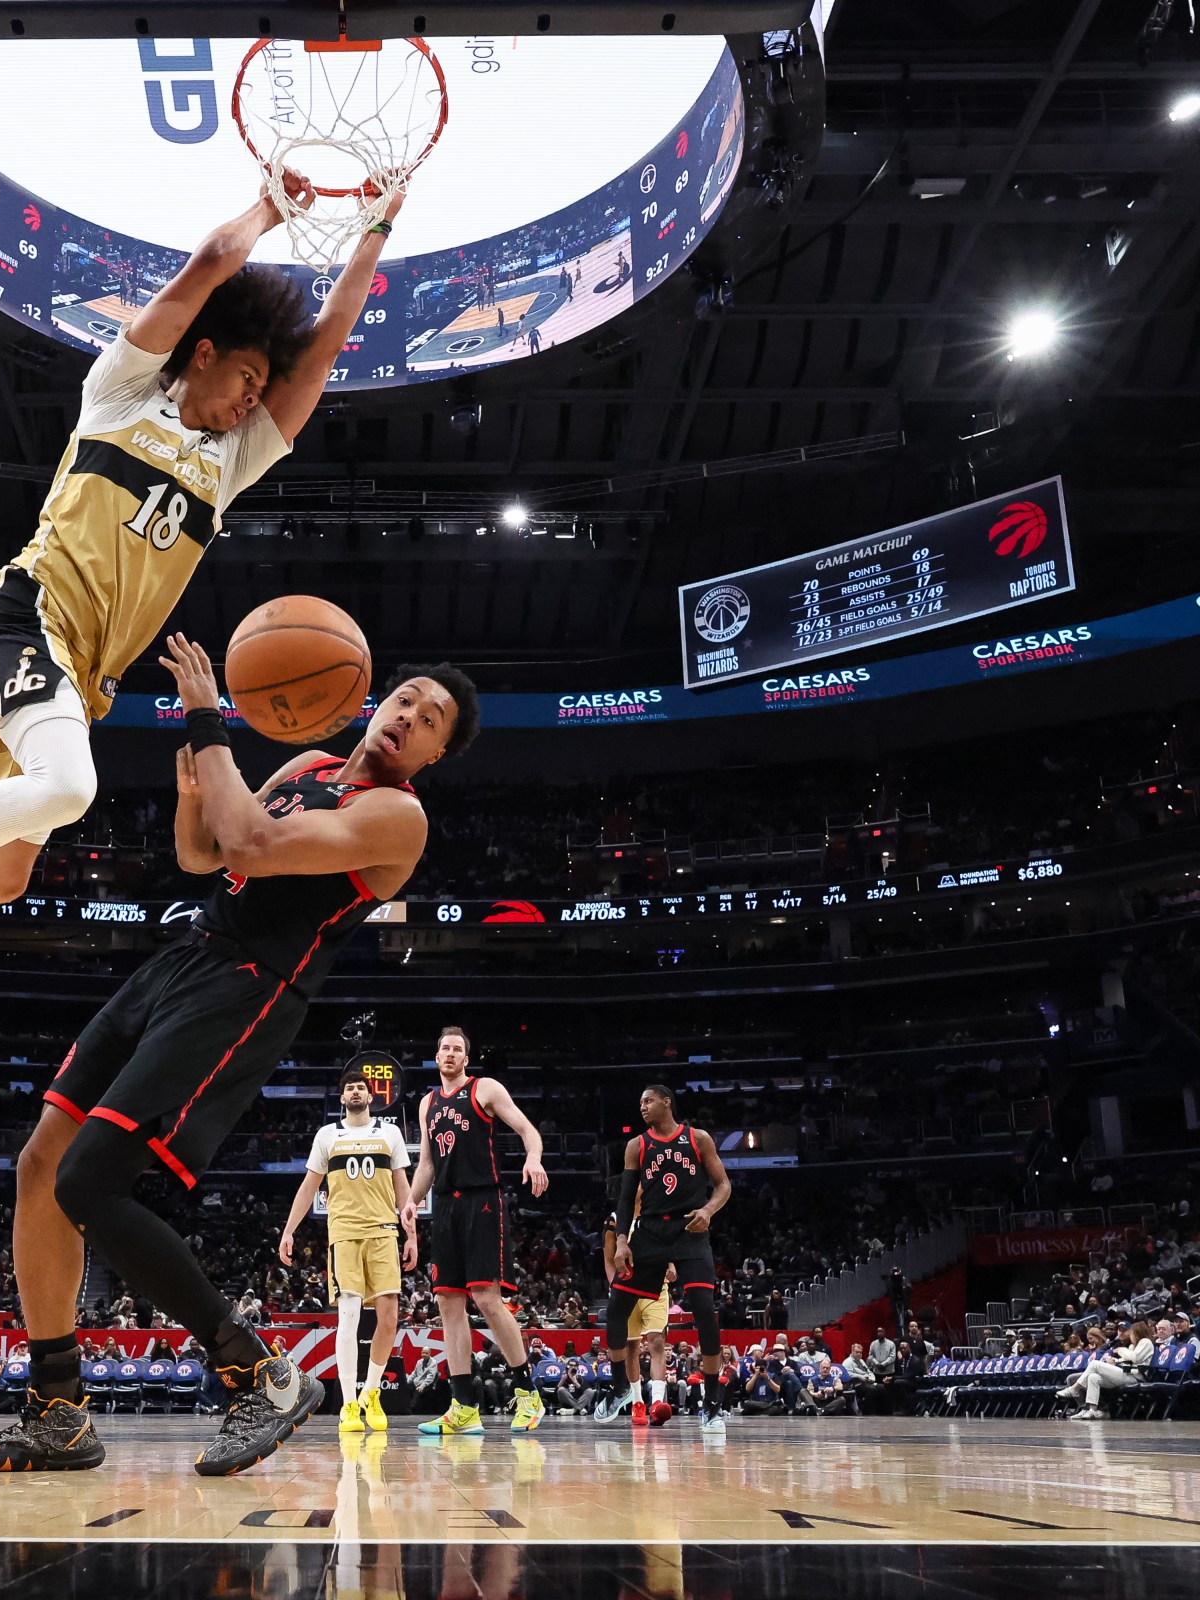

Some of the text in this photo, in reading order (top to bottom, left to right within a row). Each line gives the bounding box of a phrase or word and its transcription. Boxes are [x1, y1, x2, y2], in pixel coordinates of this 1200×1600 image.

[675, 170, 689, 194] 69
[642, 202, 658, 224] 70
[683, 226, 696, 250] :12
[19, 240, 38, 260] 69
[646, 252, 670, 283] 9:27
[22, 304, 42, 321] :12
[364, 309, 386, 325] 69
[372, 364, 395, 379] :12
[121, 483, 188, 551] 18
[815, 534, 913, 571] GAME MATCHUP
[803, 547, 929, 591] 70 POINTS 69
[1025, 560, 1055, 577] TORONTO
[803, 562, 930, 605] 23 REBOUNDS 18
[1010, 571, 1057, 598] RAPTORS
[700, 587, 743, 607] WASHINGTON
[806, 576, 932, 617] 15 ASSISTS 17
[796, 585, 944, 634] 26/45 FIELD GOALS 25/49
[707, 624, 740, 640] WIZARDS
[798, 600, 942, 647] 12/23 3-PT FIELD GOALS 5/14
[972, 626, 1092, 659] CAESARS
[697, 647, 735, 664] WASHINGTON
[978, 643, 1074, 669] SPORTSBOOK
[698, 657, 740, 678] WIZARDS
[762, 668, 870, 692] CAESARS
[559, 690, 662, 708] CAESARS
[764, 684, 855, 702] SPORTSBOOK
[558, 704, 646, 718] SPORTSBOOK
[1028, 859, 1052, 867] JACKPOT
[959, 869, 998, 879] FOUNDATION
[978, 875, 1000, 883] RAFFLE
[1018, 863, 1063, 881] $6,880
[26, 898, 46, 906] FOULS
[662, 897, 682, 905] FOULS
[822, 893, 847, 905] 5/14
[866, 887, 897, 900] 25/49
[1, 905, 13, 914] 11
[31, 907, 38, 916] 0
[88, 902, 139, 911] WASHINGTON
[575, 902, 611, 910] TORONTO
[641, 907, 648, 916] 5
[668, 905, 676, 914] 4
[698, 904, 706, 913] 4
[719, 902, 732, 911] 21
[745, 901, 757, 910] 17
[772, 897, 802, 909] 14/17
[57, 908, 63, 917] 5
[80, 907, 147, 922] WIZARDS
[436, 905, 462, 922] 69
[560, 906, 626, 922] RAPTORS
[363, 1065, 393, 1079] 9:26
[334, 1141, 383, 1152] washington
[435, 1131, 455, 1157] 19
[346, 1156, 375, 1180] 00
[646, 1148, 696, 1180] RAPTORS
[662, 1173, 677, 1195] 9
[996, 1236, 1078, 1257] Hennessy
[381, 1380, 399, 1390] One
